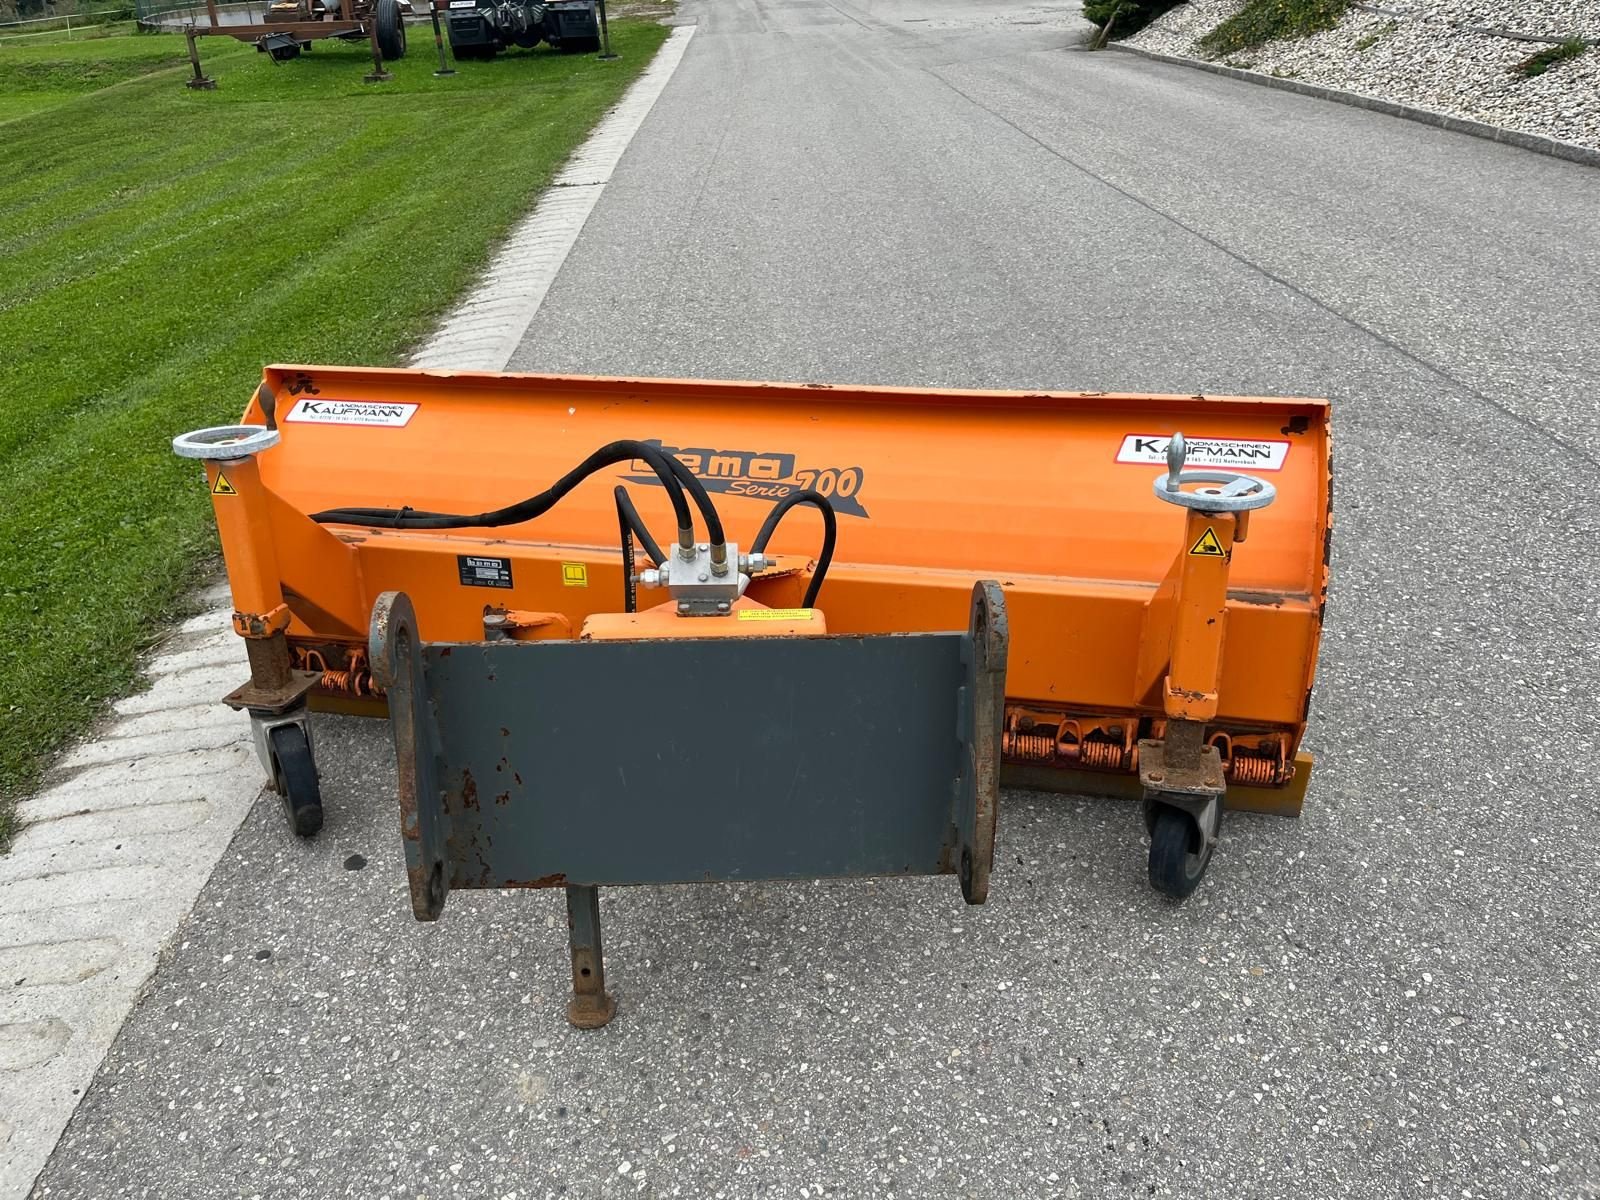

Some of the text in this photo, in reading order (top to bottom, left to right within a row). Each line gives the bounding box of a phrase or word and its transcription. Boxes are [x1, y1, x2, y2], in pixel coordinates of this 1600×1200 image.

[302, 402, 403, 417] KAUFMANN
[1185, 439, 1271, 450] NDMASCHINEN
[725, 468, 862, 498] Serie 700
